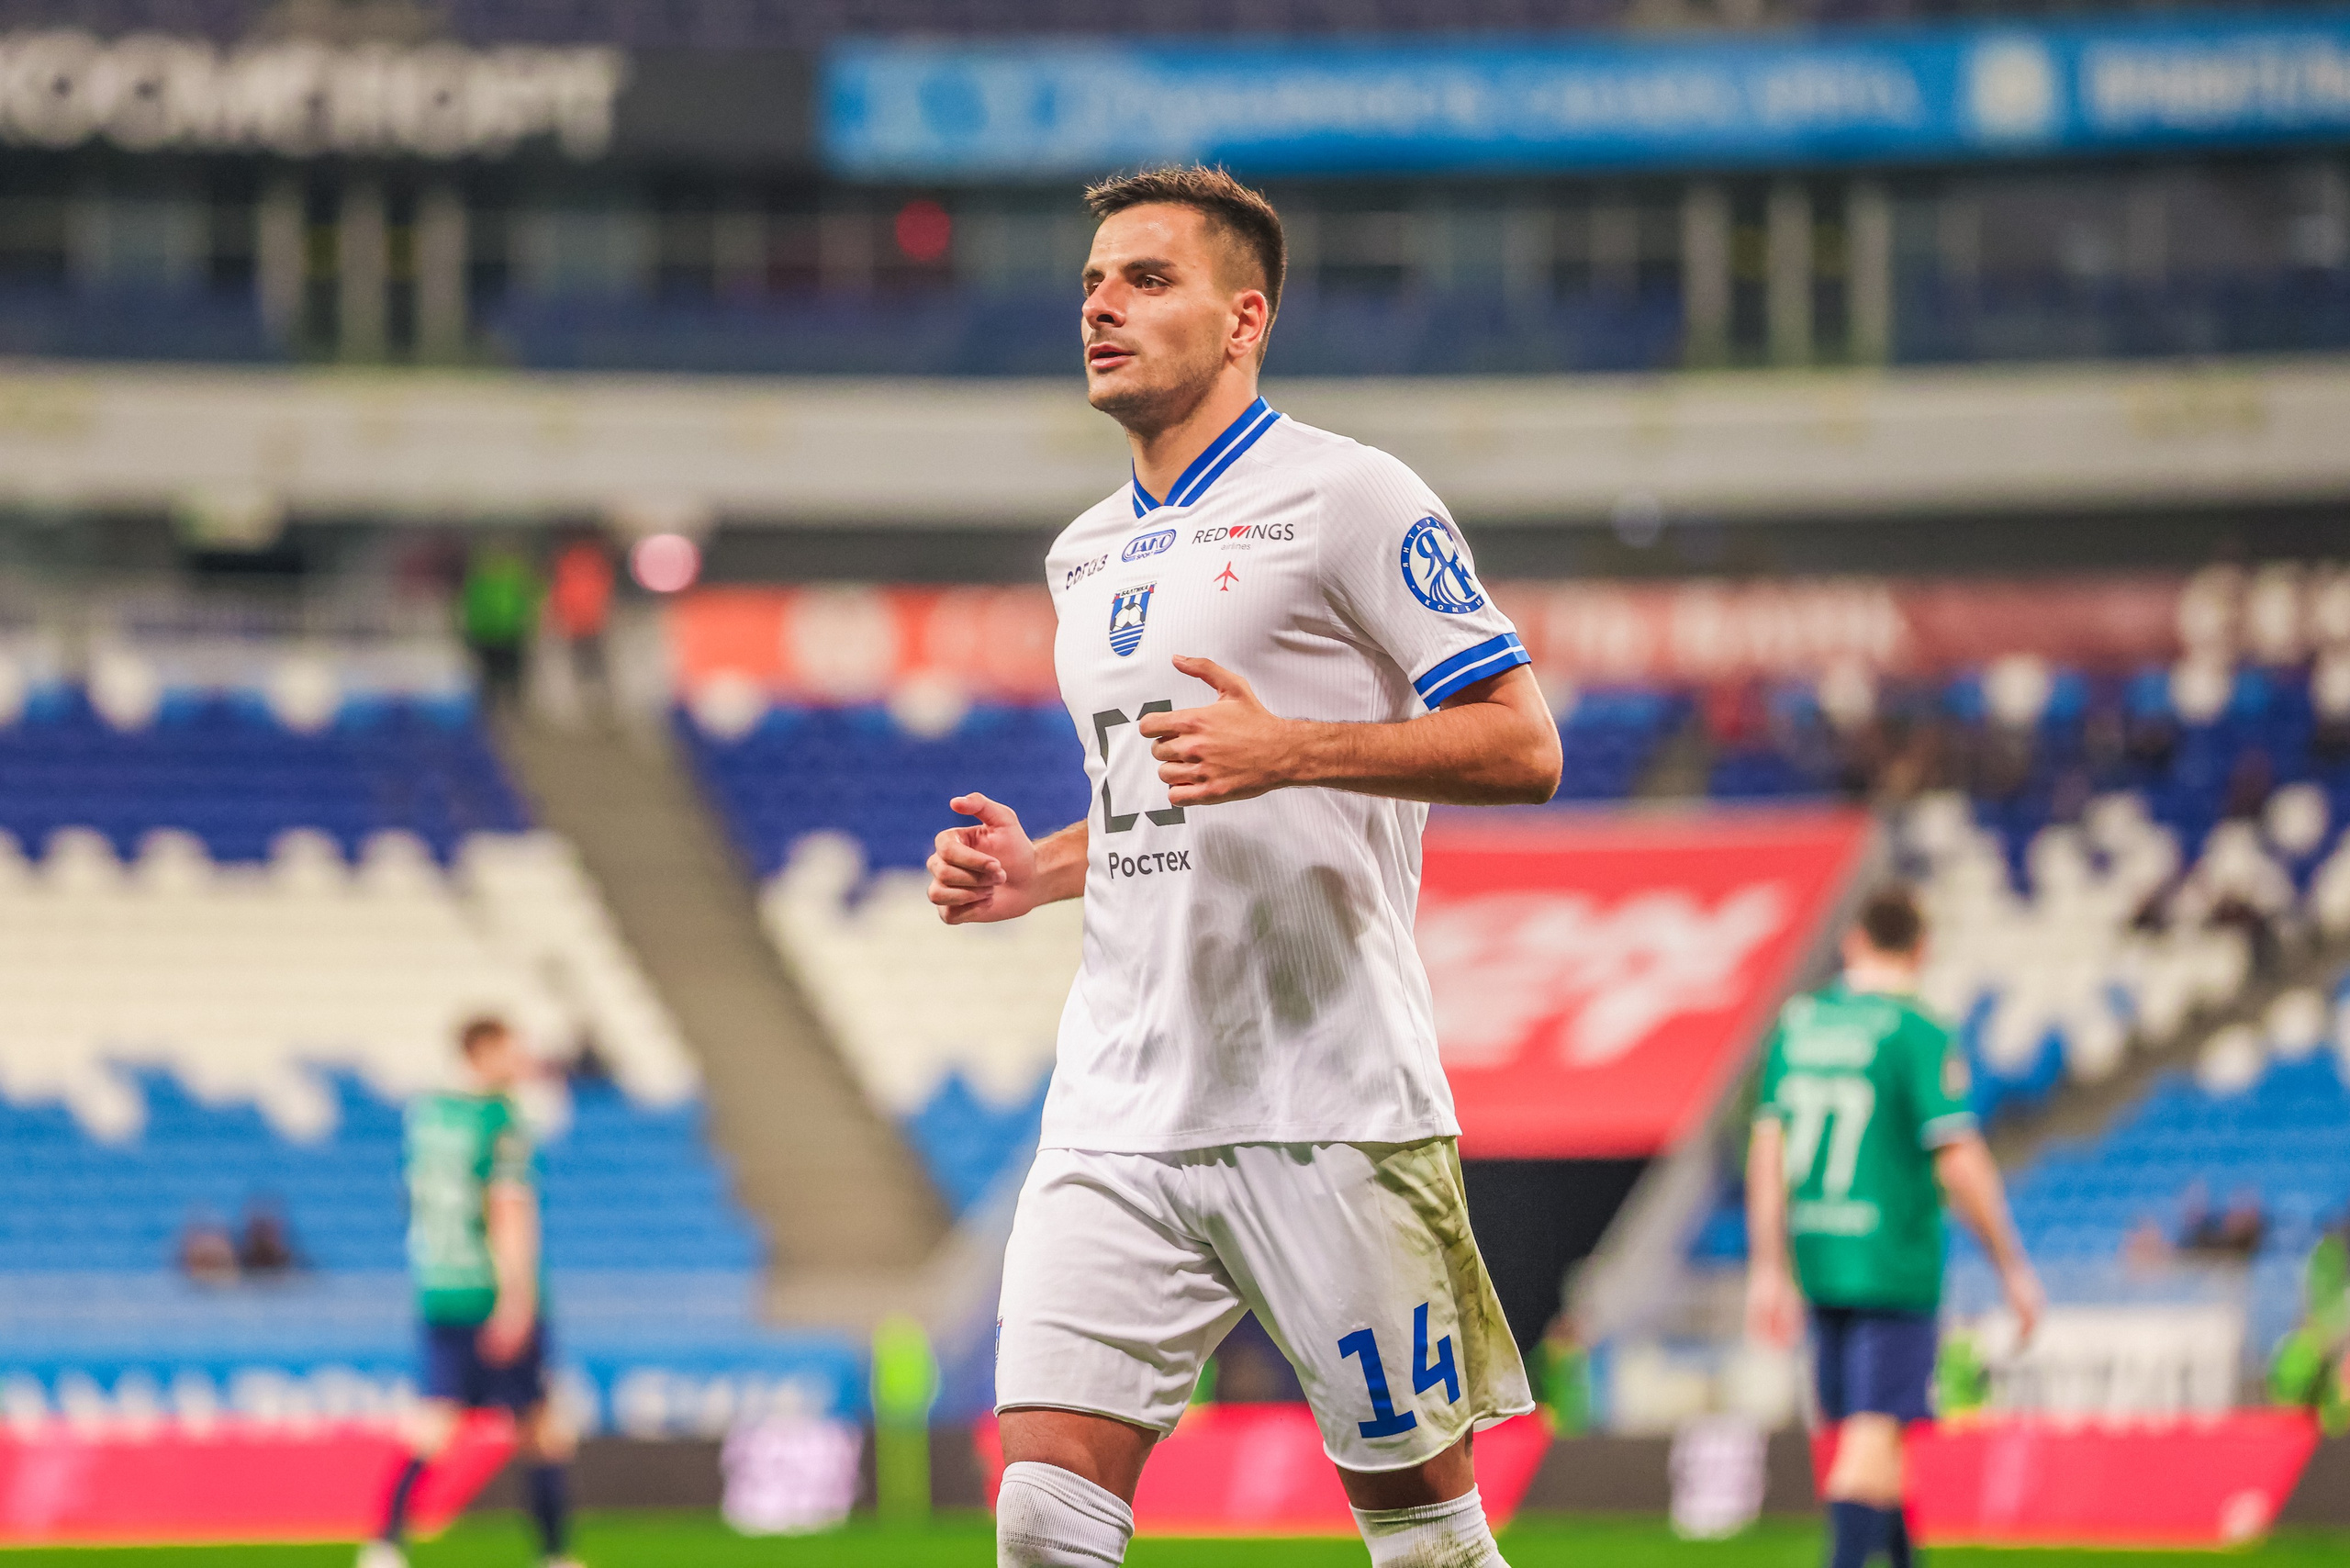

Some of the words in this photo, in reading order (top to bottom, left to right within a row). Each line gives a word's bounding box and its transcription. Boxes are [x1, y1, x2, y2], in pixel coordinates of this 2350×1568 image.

[1221, 543, 1251, 551] airlines
[1108, 850, 1192, 879] Ростех
[1337, 1302, 1460, 1439] 14
